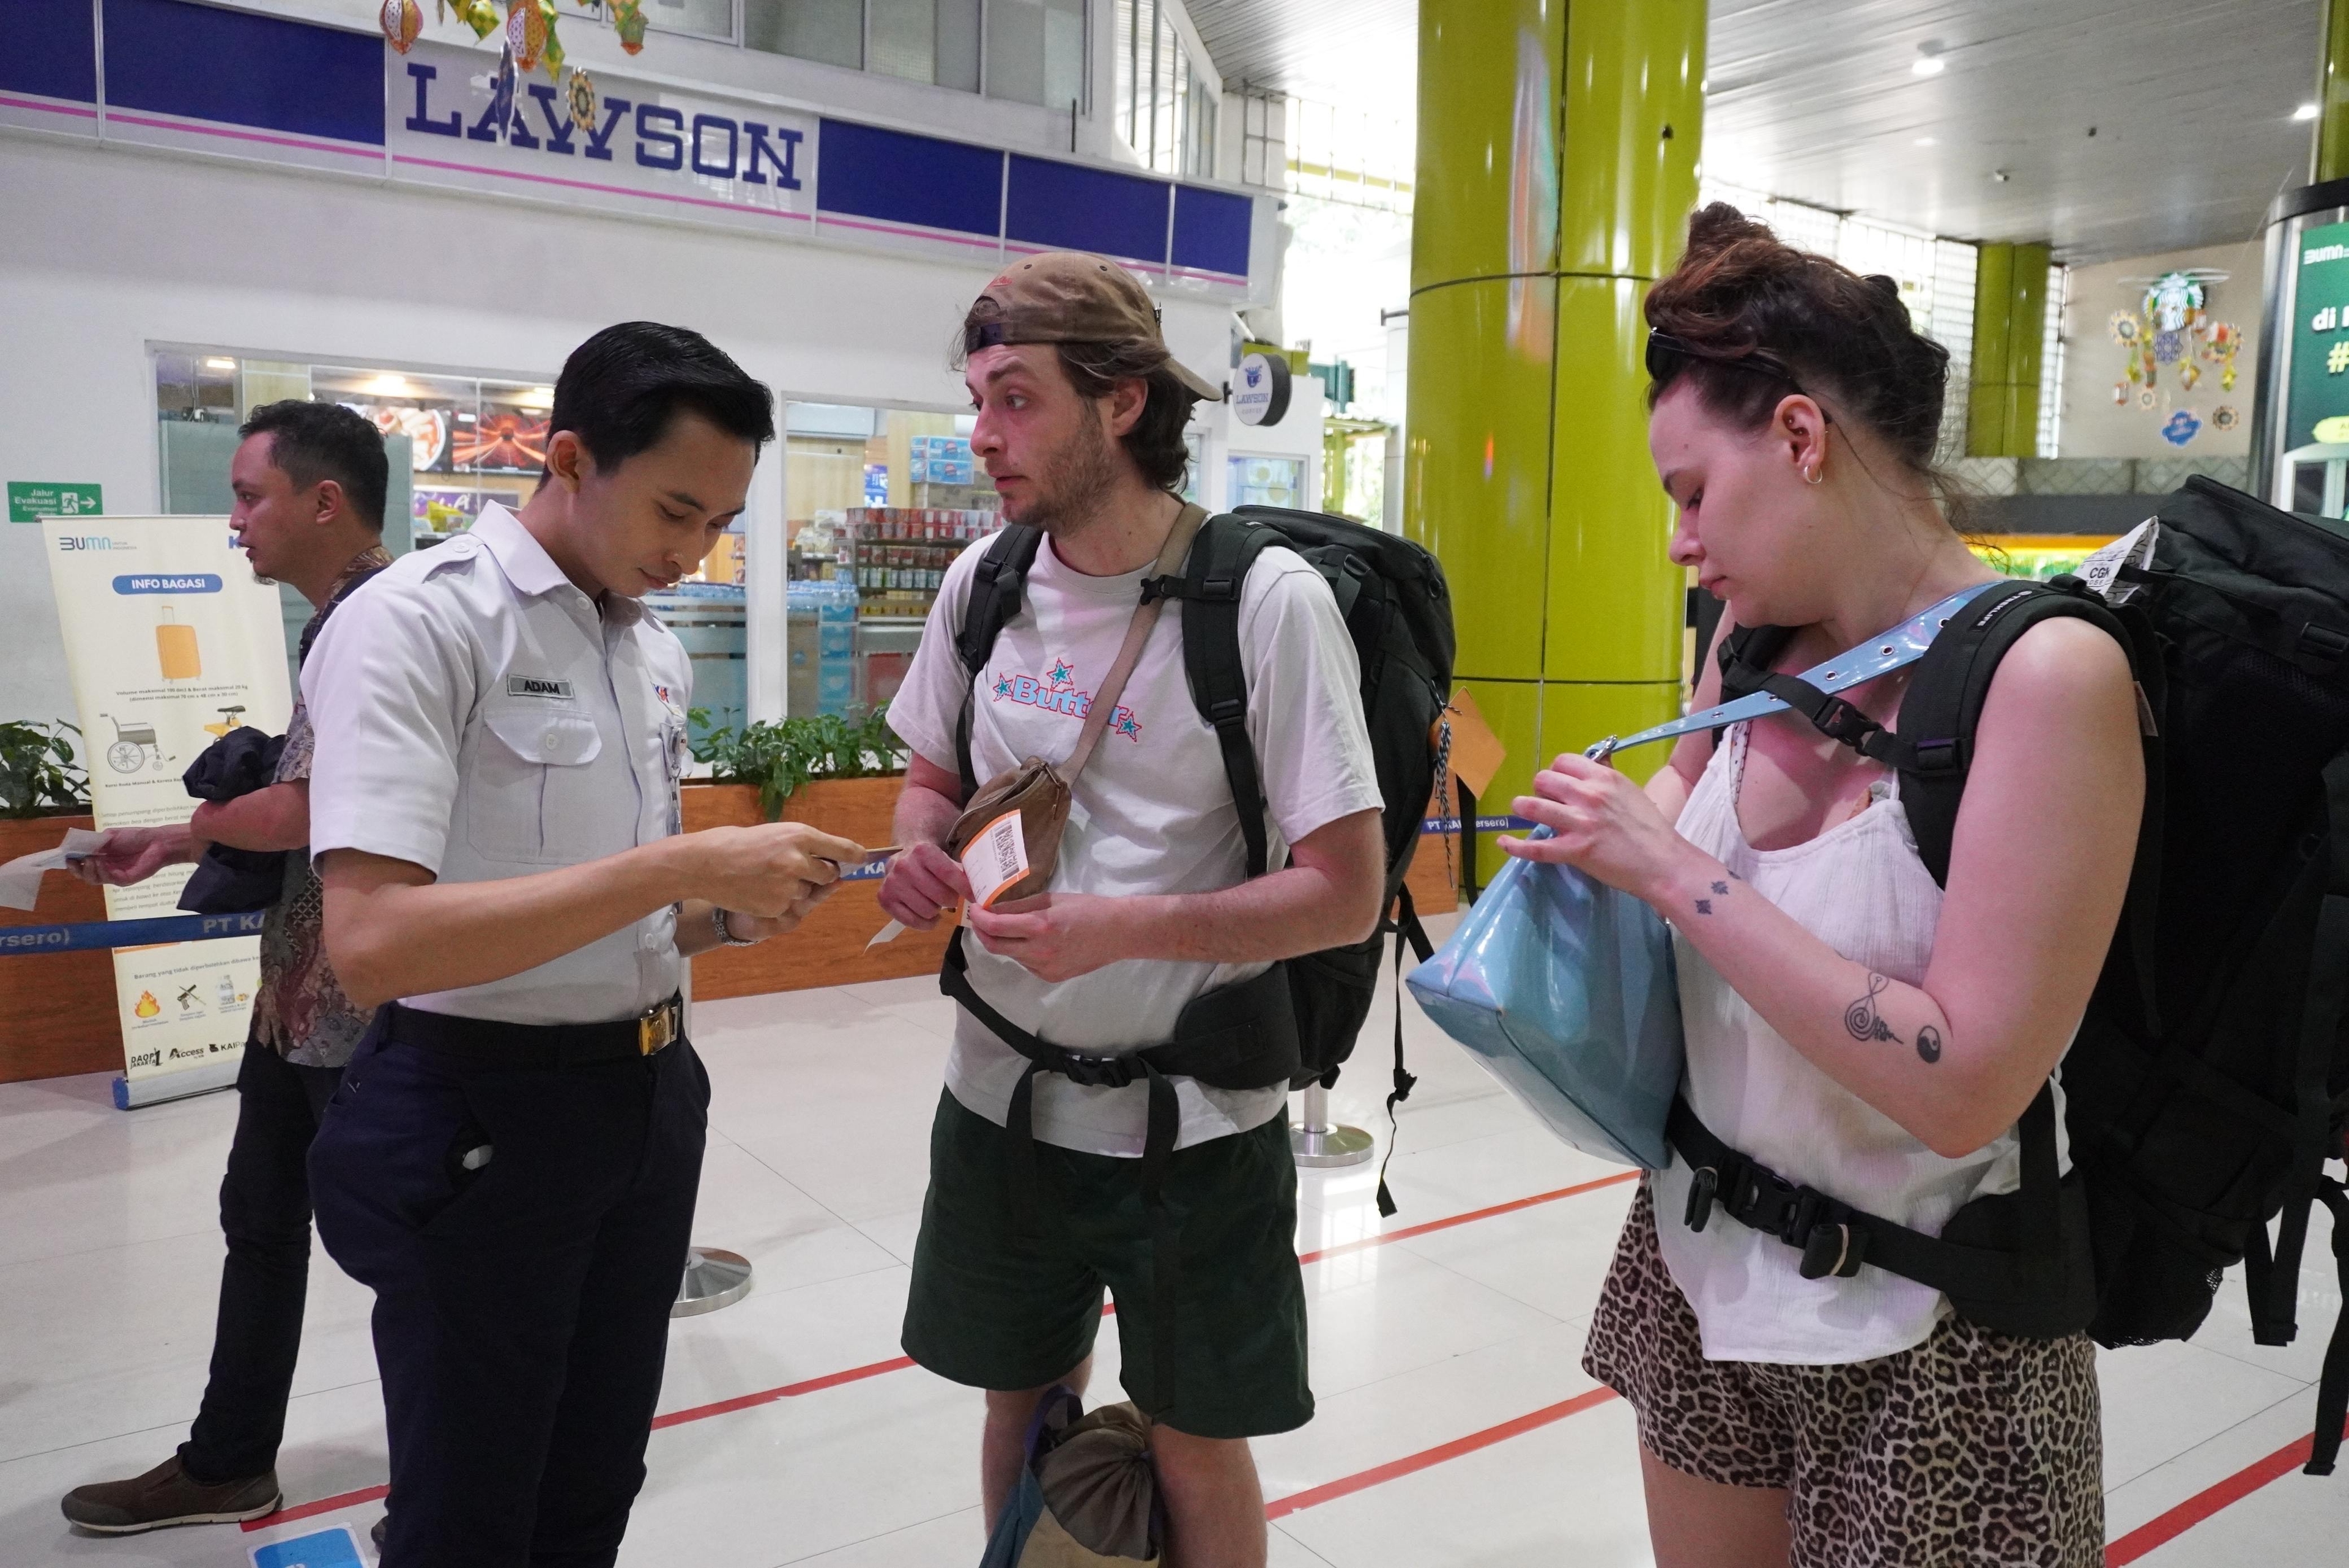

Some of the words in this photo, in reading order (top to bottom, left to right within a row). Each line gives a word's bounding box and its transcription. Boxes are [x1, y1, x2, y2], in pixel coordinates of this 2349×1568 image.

[406, 62, 803, 190] LAWSON
[2312, 307, 2336, 331] di
[1236, 393, 1269, 404] LAWSON
[132, 580, 160, 589] INFO
[162, 579, 206, 589] BAGASI
[524, 680, 560, 694] ADAM
[1011, 675, 1130, 727] Buttr
[1427, 821, 1440, 830] PT
[1475, 817, 1508, 828] ersero)
[864, 861, 885, 875] KA
[203, 917, 232, 933] PT
[190, 961, 230, 971] diperbolehkan
[221, 1041, 245, 1051] KAIPa
[131, 1053, 154, 1063] DAOP
[169, 1048, 204, 1060] Access
[130, 1059, 156, 1070] JAKARTA
